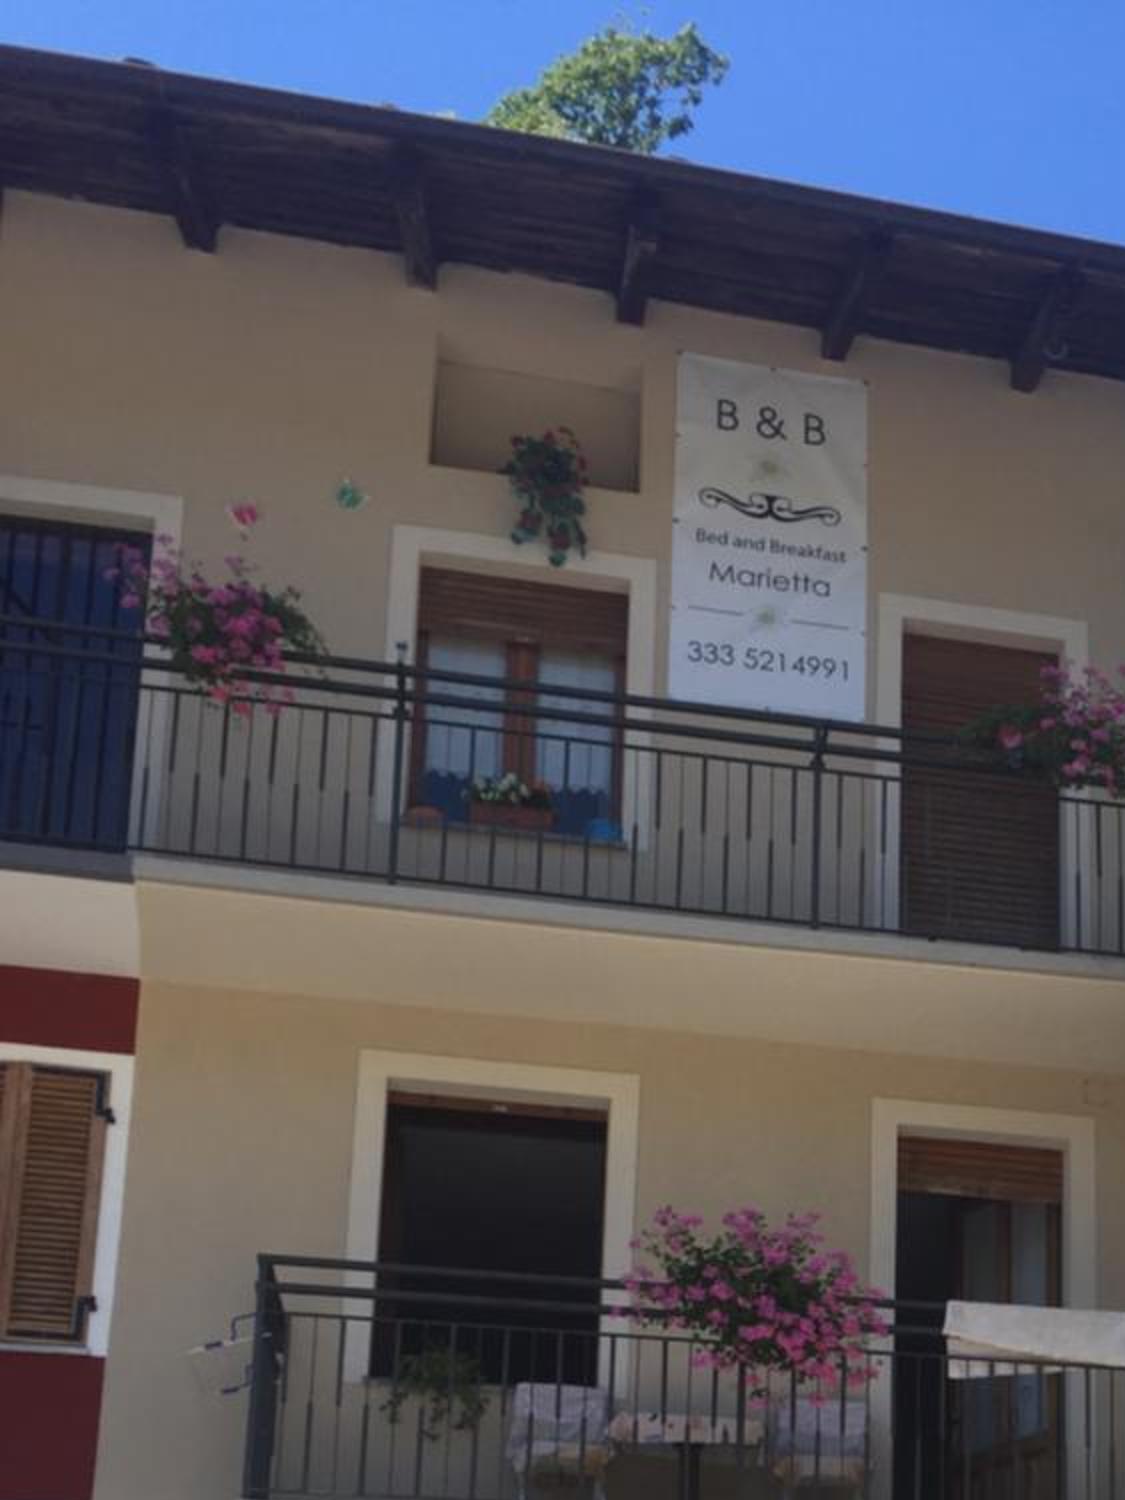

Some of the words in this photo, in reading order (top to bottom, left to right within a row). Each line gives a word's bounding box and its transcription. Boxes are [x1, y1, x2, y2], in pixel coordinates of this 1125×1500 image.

[715, 399, 740, 432] B
[755, 405, 787, 441] &
[803, 412, 827, 446] B
[695, 527, 730, 547] Bed
[732, 535, 766, 553] and
[769, 539, 848, 565] Breakfast
[708, 560, 832, 598] Marietta
[687, 640, 736, 667] 333
